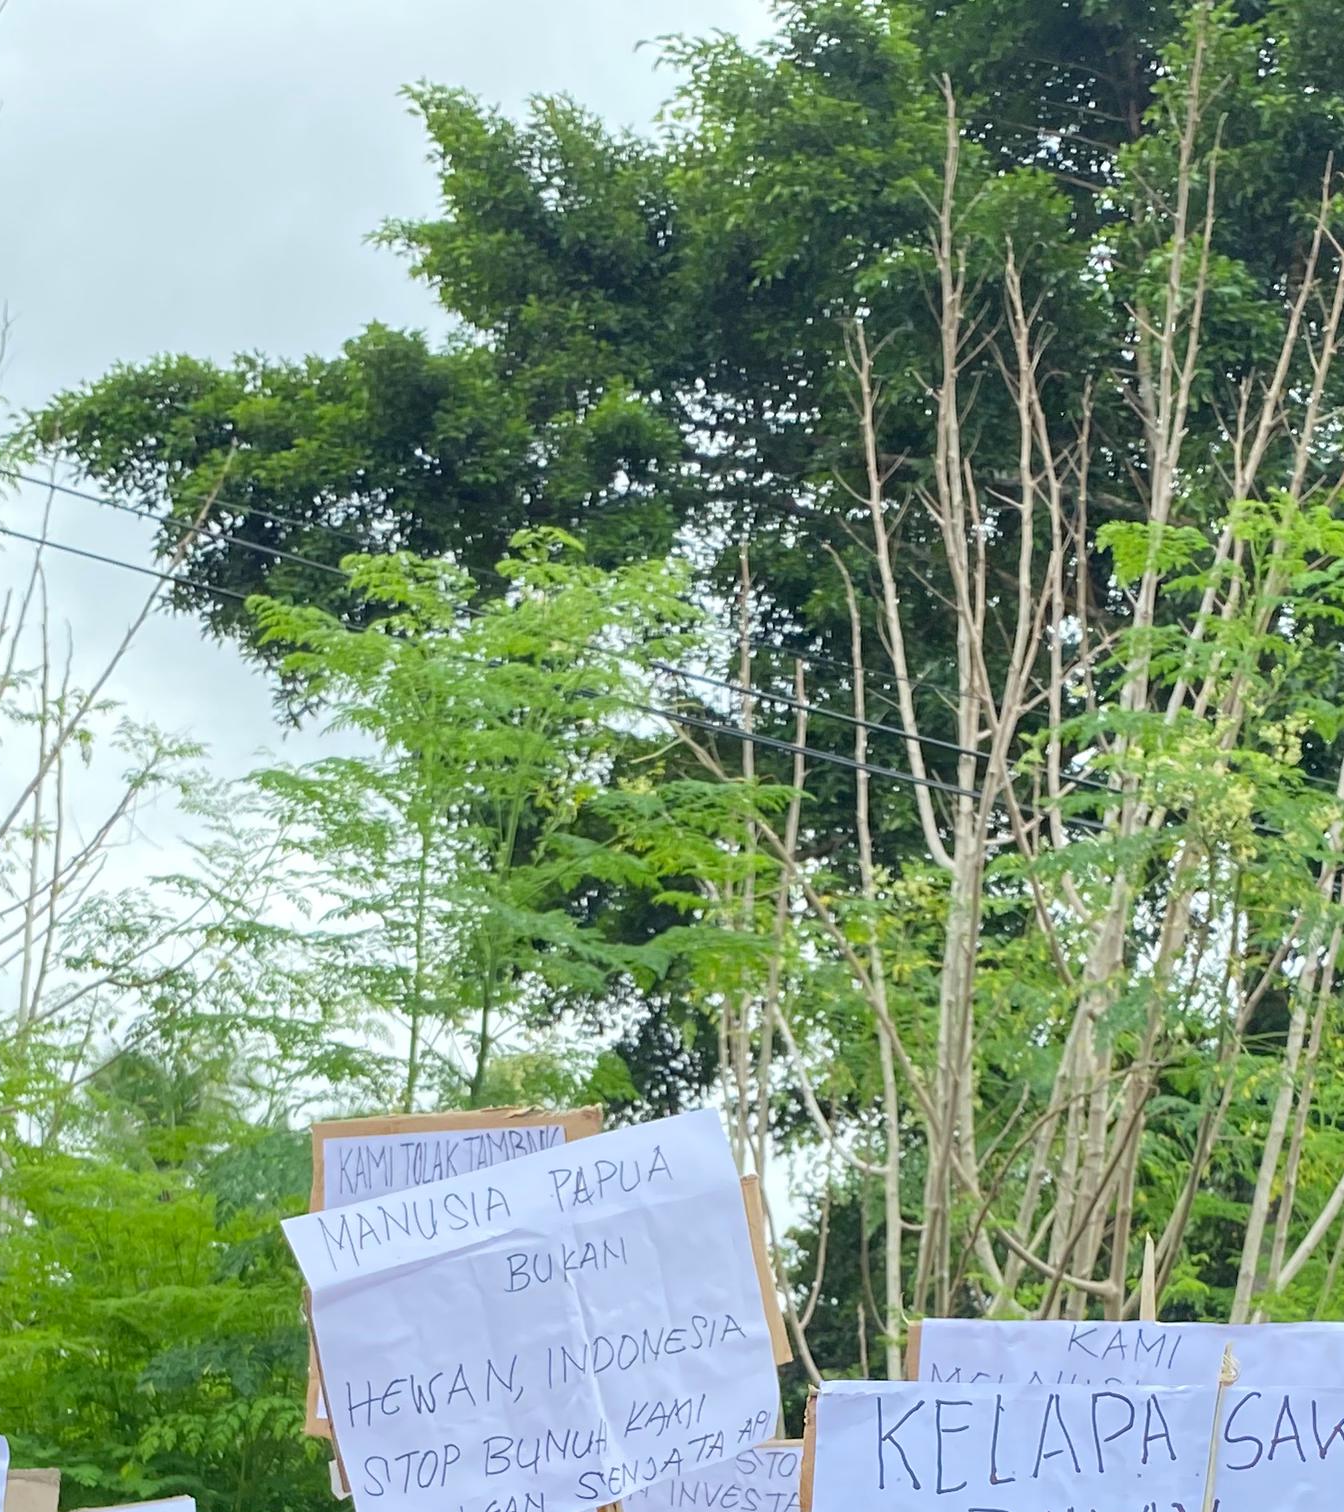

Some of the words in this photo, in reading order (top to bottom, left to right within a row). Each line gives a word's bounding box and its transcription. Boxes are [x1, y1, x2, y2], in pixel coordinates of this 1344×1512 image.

[317, 1187, 512, 1272] MANUSIA
[549, 1146, 674, 1211] PAPUA
[339, 1145, 394, 1194] KAMI
[504, 1238, 629, 1294] BUKAN
[345, 1354, 526, 1427] HEWAN,
[548, 1314, 749, 1390] INDONESIA
[1068, 1325, 1182, 1369] KAMI
[363, 1442, 461, 1498] STOP
[624, 1393, 707, 1436] KAMI
[736, 1409, 772, 1444] API
[877, 1392, 1178, 1496] KELAPA
